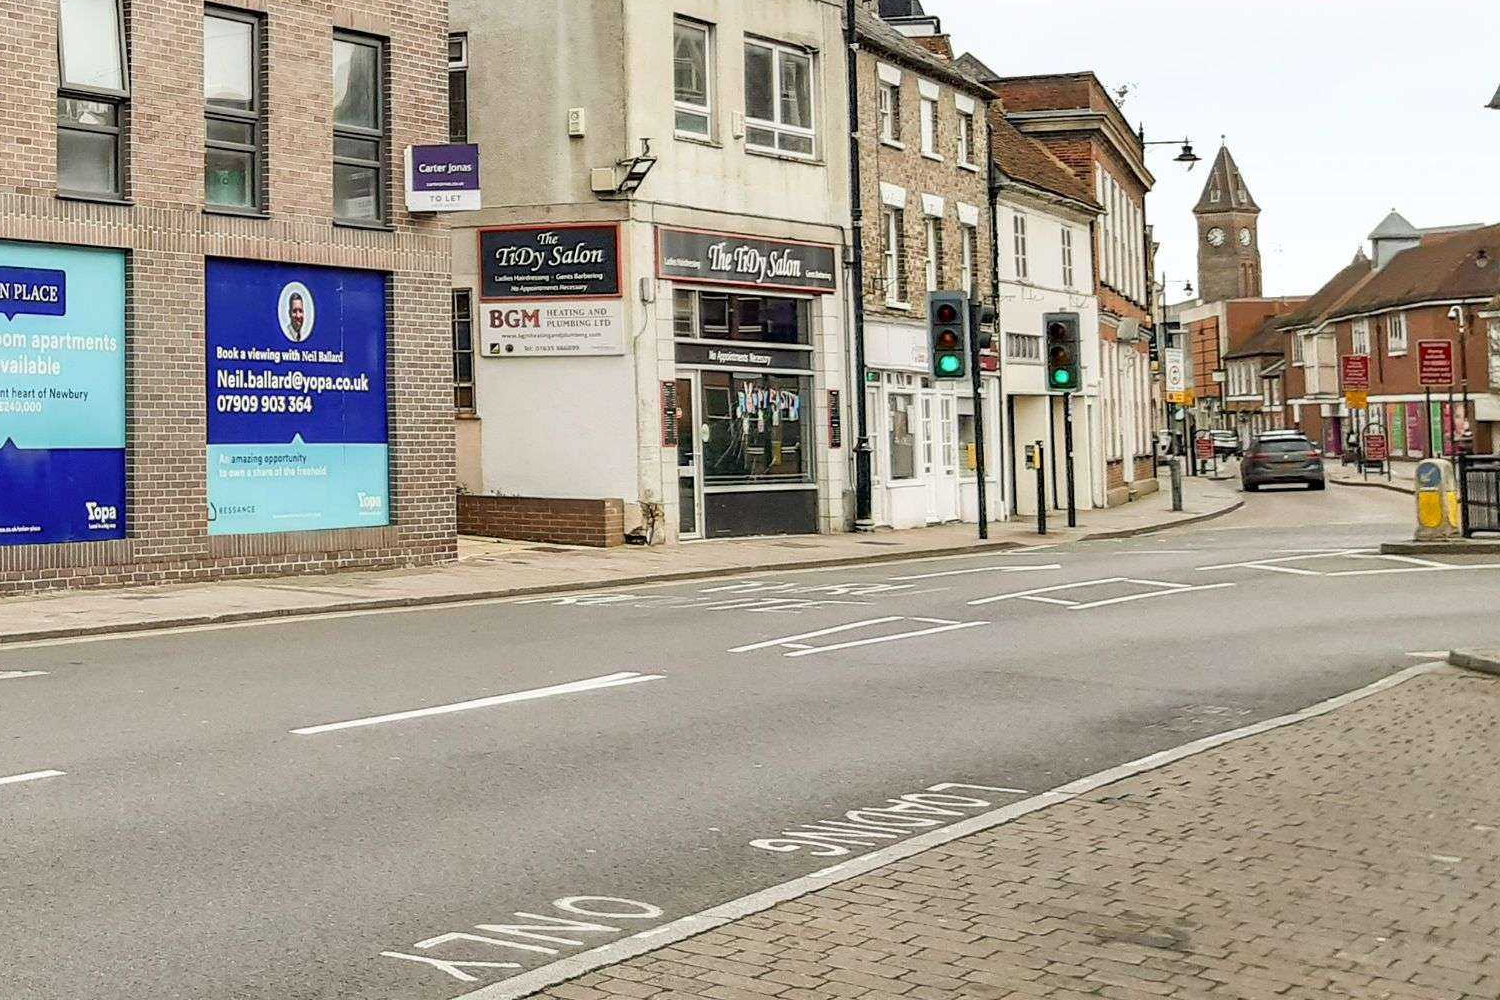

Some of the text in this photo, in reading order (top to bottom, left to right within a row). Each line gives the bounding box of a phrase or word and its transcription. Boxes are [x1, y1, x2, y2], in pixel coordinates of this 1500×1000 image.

[418, 162, 472, 174] Carter Jonas
[537, 231, 559, 245] The
[495, 242, 604, 272] TiDy Salon
[708, 242, 801, 284] The TiDy Salon
[14, 283, 59, 302] PLACE
[489, 308, 607, 328] BGM HEATING AND
[546, 319, 611, 328] PLUMBING LTD
[31, 331, 117, 353] apartments
[216, 346, 343, 363] Book a viewing with Neil Ballard
[216, 369, 369, 394] Neil.ballard@yopa.co.uk
[12, 387, 36, 399] heart
[38, 388, 47, 399] of
[49, 387, 89, 401] Newbury
[216, 395, 312, 413] 07909 903 364
[231, 454, 264, 465] amazing
[264, 453, 307, 465] opportunity
[219, 468, 227, 477] to
[229, 469, 245, 477] own
[252, 467, 272, 477] share
[273, 467, 282, 477] of
[283, 466, 296, 476] the
[85, 501, 116, 522] Yopa
[219, 505, 256, 515] RESSANCE
[749, 782, 1027, 857] LOADING
[380, 895, 664, 982] ONLY
